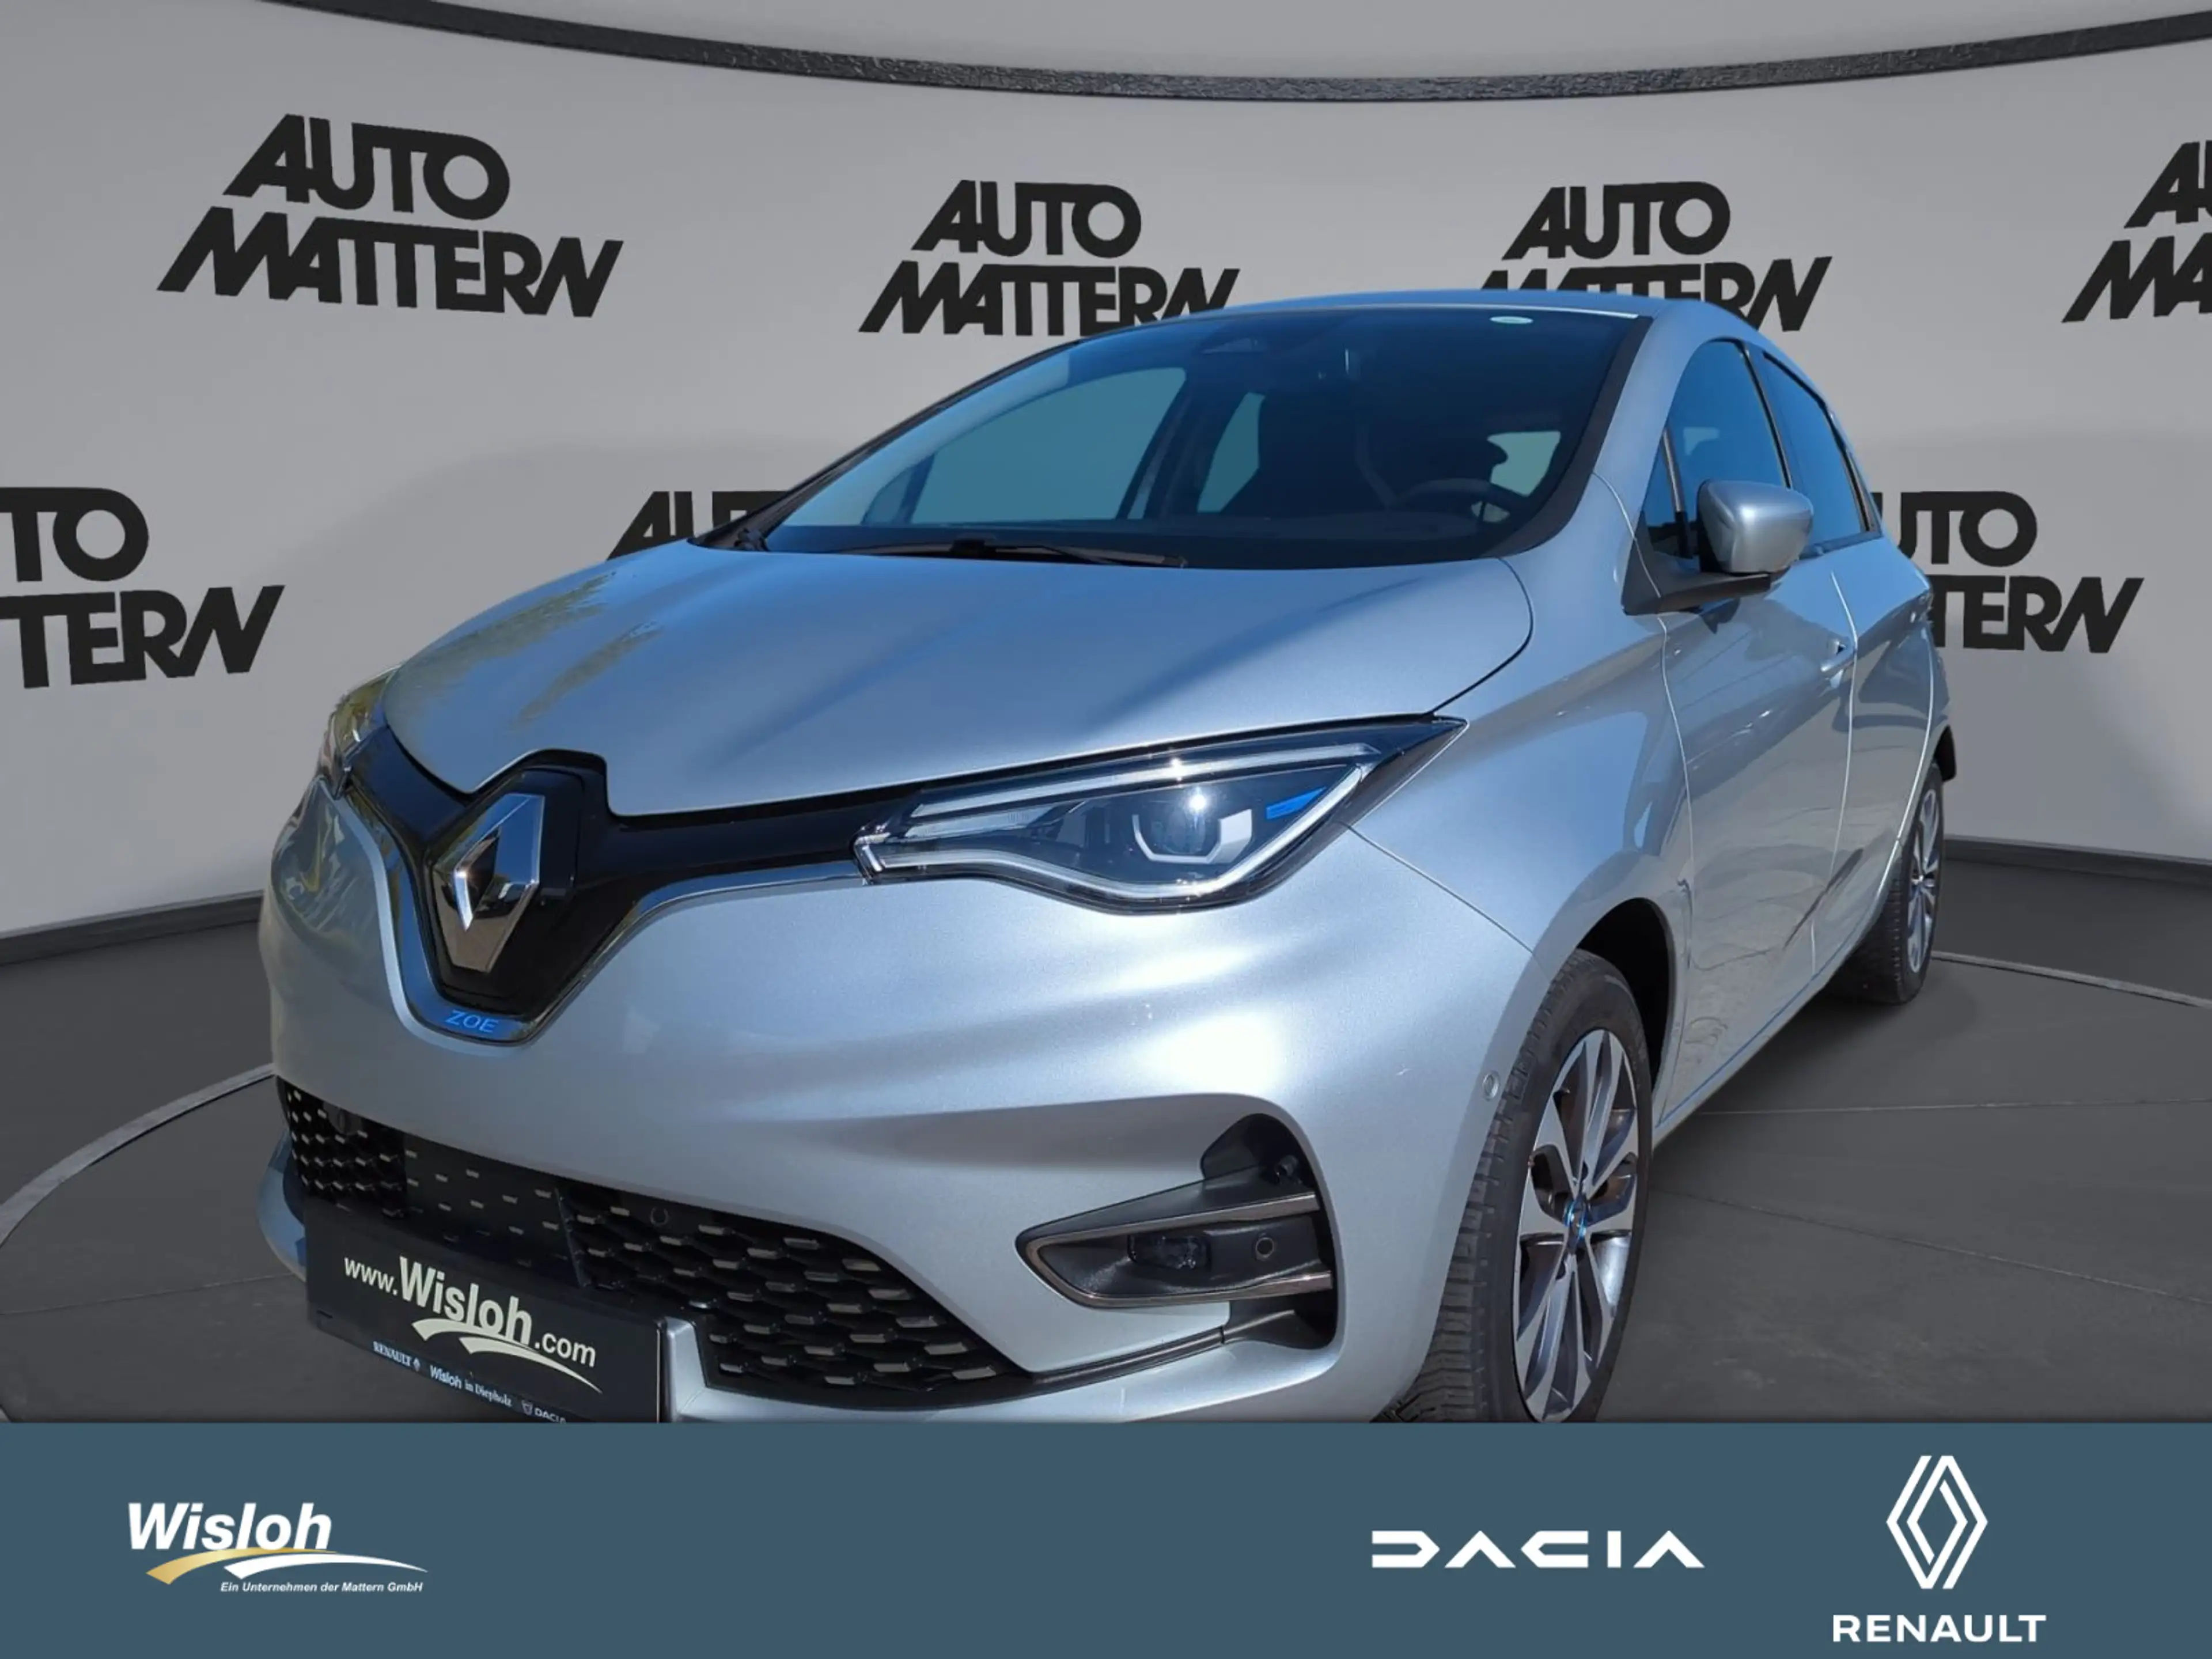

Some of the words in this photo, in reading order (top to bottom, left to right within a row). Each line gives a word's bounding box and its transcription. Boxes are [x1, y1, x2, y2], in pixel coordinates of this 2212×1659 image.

[223, 114, 510, 221] AUTO
[911, 180, 1141, 258] AUTO
[1502, 181, 1730, 260] AUTO
[157, 206, 624, 317] MATTERN
[858, 260, 1241, 336] MATTERN
[0, 487, 149, 582] TO
[1870, 491, 2037, 567] UTO
[0, 585, 285, 688] TERN
[1925, 574, 2145, 653] TERN
[445, 1009, 499, 1033] ZOE
[344, 1256, 596, 1368] www.Wisloh.com
[373, 1341, 412, 1367] RENAULT
[430, 1364, 463, 1390] Wisloh
